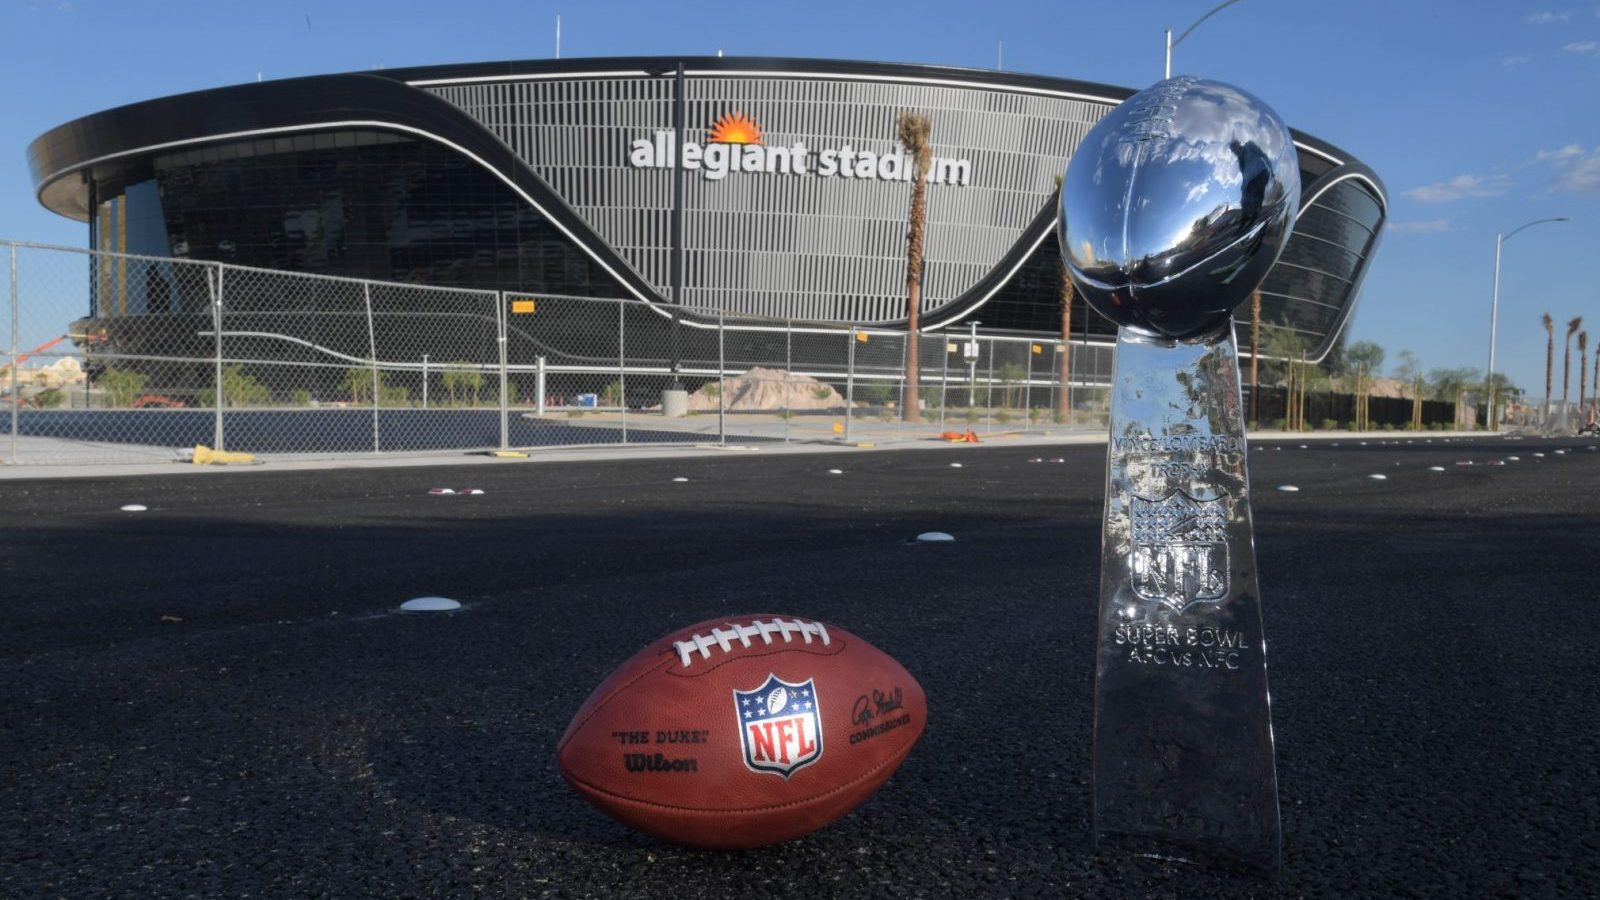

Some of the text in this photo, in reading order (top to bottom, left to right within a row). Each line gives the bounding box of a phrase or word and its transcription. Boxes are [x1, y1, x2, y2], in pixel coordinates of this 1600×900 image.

[631, 130, 808, 181] allegiant
[1114, 436, 1160, 451] VINCE
[1138, 543, 1225, 602] NFL
[1115, 623, 1249, 649] SUPER BOWL
[1128, 646, 1167, 665] AFC
[749, 717, 816, 765] NFL
[624, 753, 698, 772] Wilson
